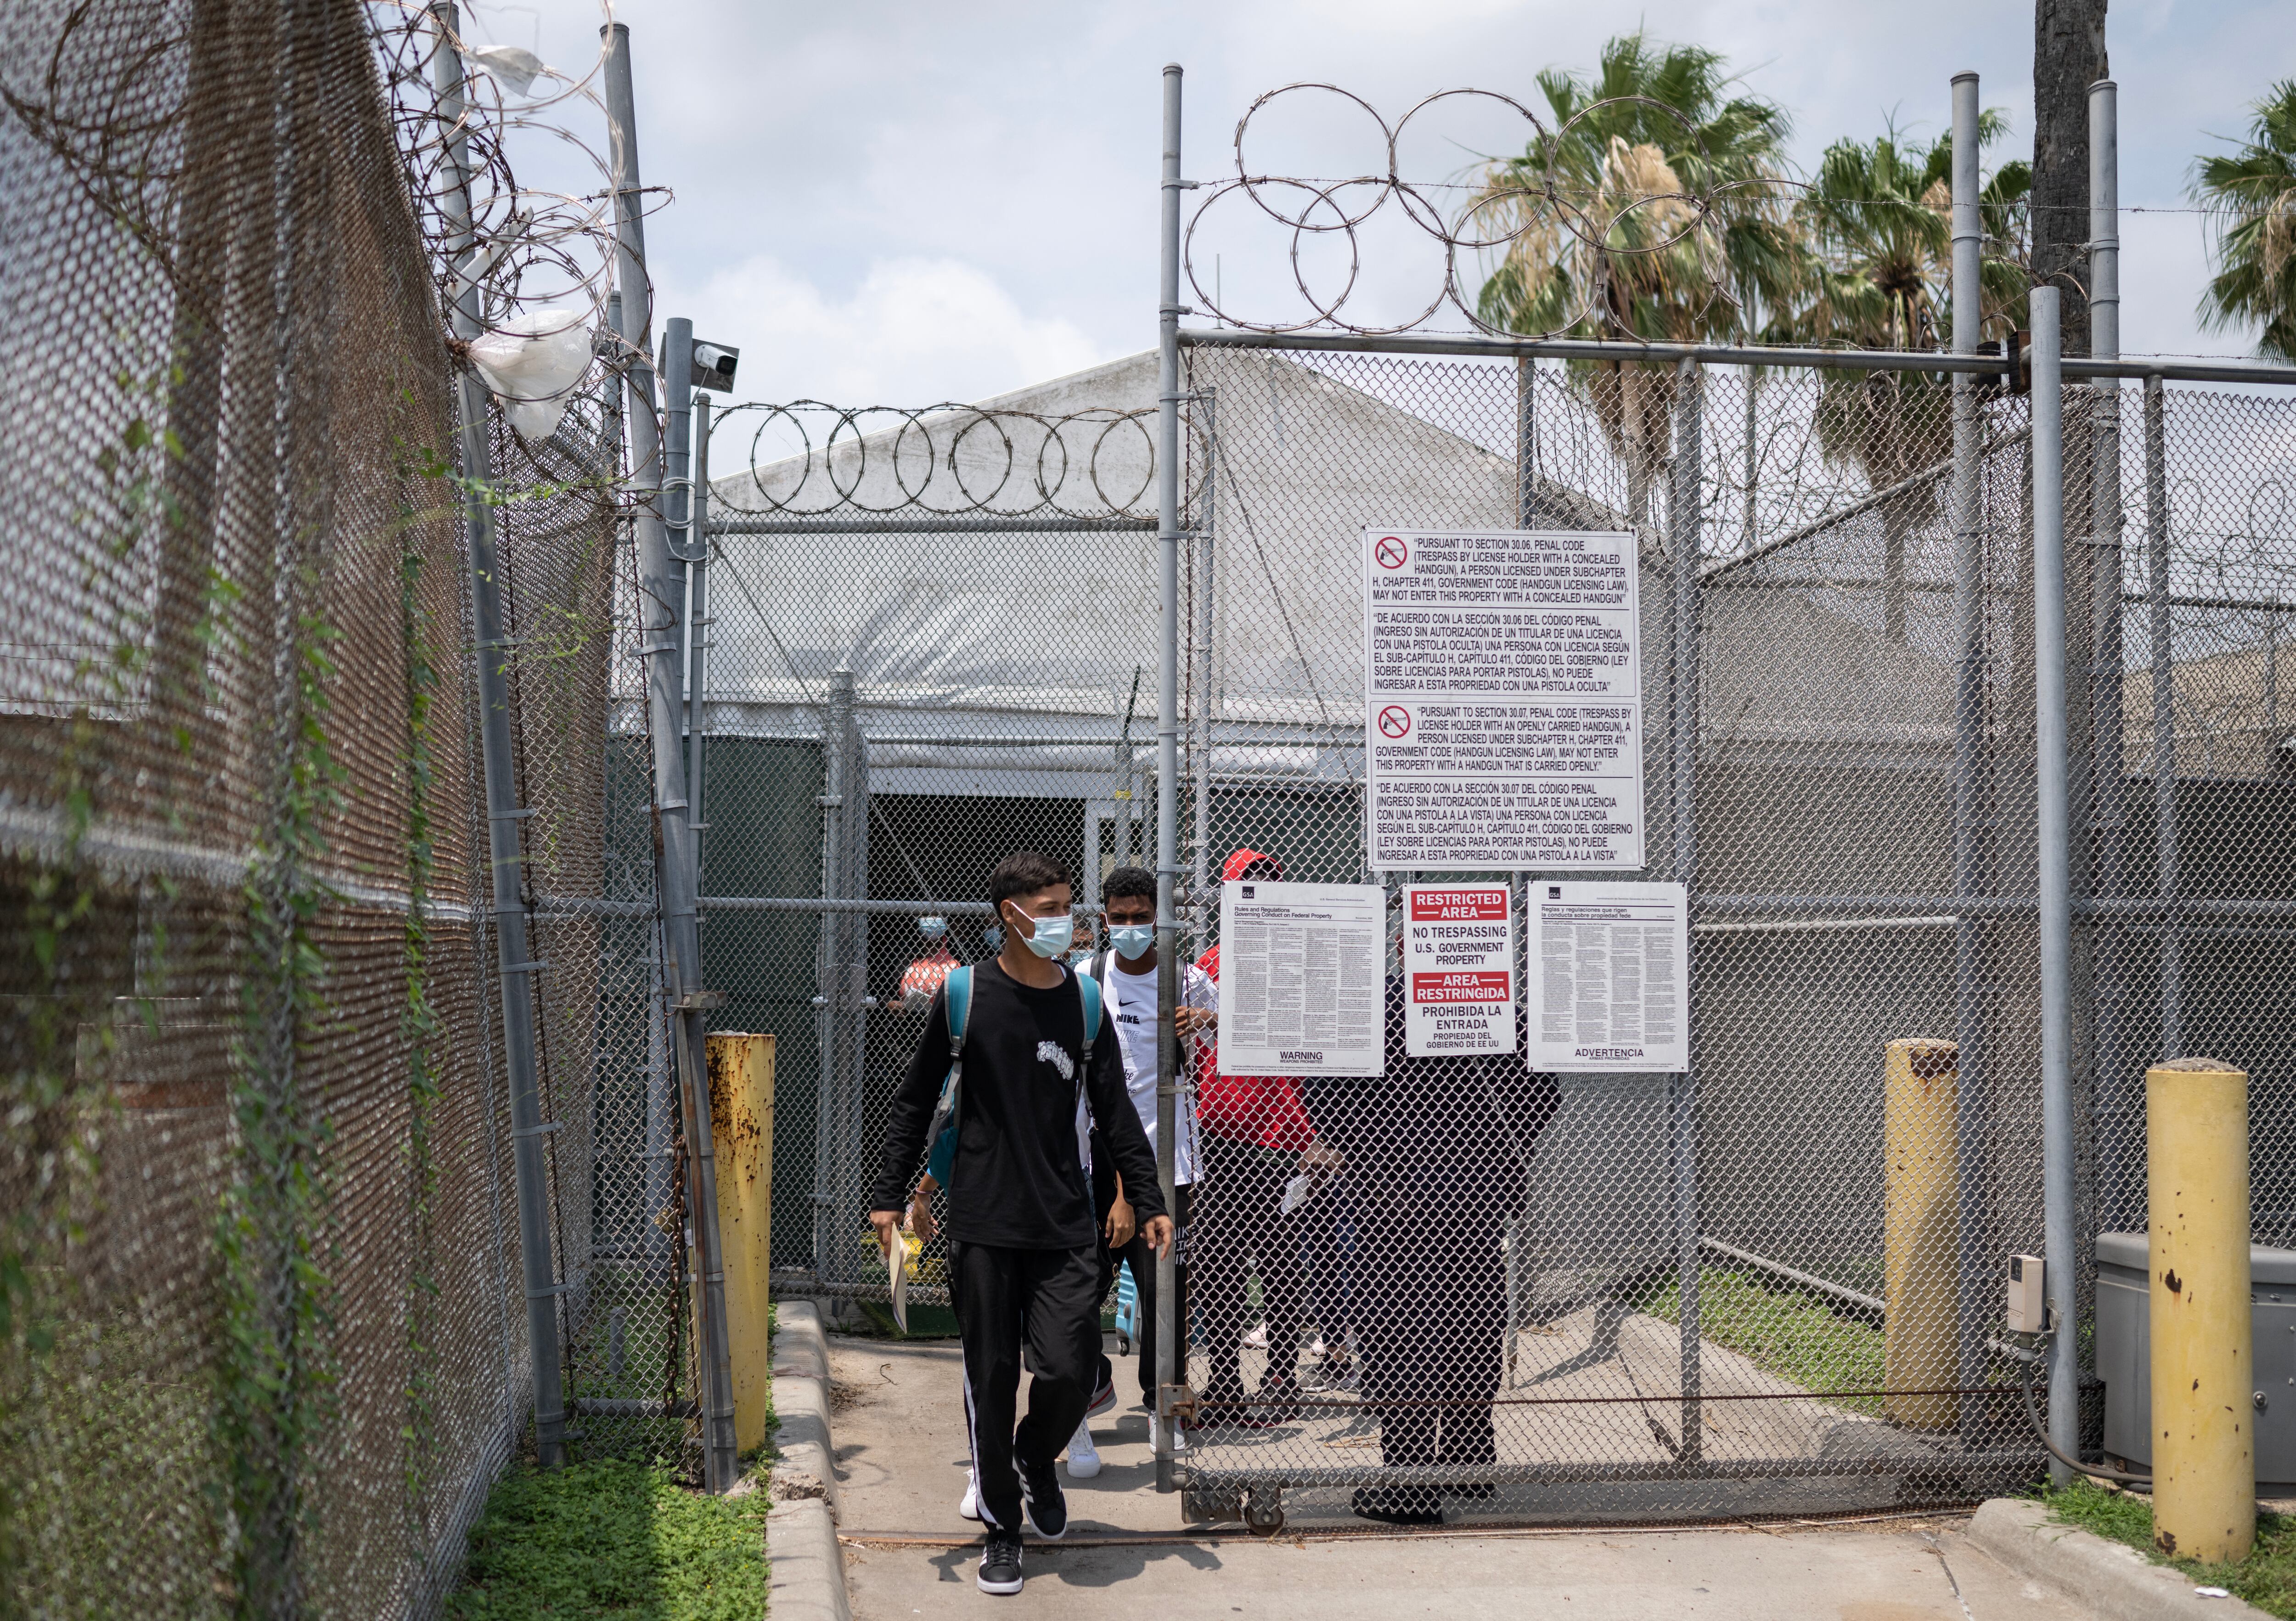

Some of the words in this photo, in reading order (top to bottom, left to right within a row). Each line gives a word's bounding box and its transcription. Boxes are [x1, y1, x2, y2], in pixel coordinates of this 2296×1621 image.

[1462, 539, 1473, 548] TO
[1475, 539, 1509, 549] SECTION
[1511, 540, 1532, 551] 30.06,
[1535, 540, 1560, 550] PENAL
[1563, 540, 1584, 551] CODE
[1414, 551, 1458, 563] (TRESPASS
[1460, 552, 1470, 562] BY
[1473, 552, 1505, 562] LICENSE
[1508, 552, 1540, 563] HOLDER
[1542, 553, 1561, 563] WITH
[1564, 553, 1570, 563] A
[1572, 553, 1620, 564] CONCEALED
[1414, 564, 1458, 577] HANDGUN),
[1460, 565, 1466, 574] A
[1469, 565, 1500, 575] PERSON
[1503, 565, 1541, 576] LICENSED
[1543, 566, 1570, 576] UNDER
[1573, 567, 1625, 577] SUBCHAPTER
[1373, 577, 1380, 588] H,
[1383, 577, 1420, 587] CHAPTER
[1422, 577, 1435, 589] 411,
[1438, 578, 1493, 588] GOVERNMENT
[1496, 579, 1517, 589] CODE
[1520, 579, 1561, 591] (HANDGUN
[1564, 580, 1604, 590] LICENSING
[1607, 580, 1628, 592] LAW),
[1373, 590, 1390, 600] MAY
[1392, 590, 1408, 600] NOT
[1411, 591, 1436, 601] ENTER
[1439, 591, 1456, 601] THIS
[1459, 591, 1501, 602] PROPERTY
[1503, 591, 1522, 602] WITH
[1525, 592, 1531, 602] A
[1533, 592, 1581, 602] CONCEALED
[1390, 613, 1430, 623] ACUERDO
[1432, 614, 1449, 624] CON
[1452, 614, 1463, 624] LA
[1465, 612, 1500, 624] SECCIÓN
[1503, 614, 1521, 625] 30.06
[1524, 615, 1539, 625] DEL
[1542, 613, 1573, 625] CÓDIGO
[1576, 615, 1601, 626] PENAL
[1373, 626, 1412, 638] (INGRESO
[1414, 626, 1427, 636] SIN
[1430, 625, 1489, 637] AUTORIZACIÓN
[1491, 628, 1502, 637] DE
[1505, 628, 1515, 637] UN
[1518, 628, 1551, 638] TITULAR
[1554, 629, 1564, 638] DE
[1567, 629, 1583, 638] UNA
[1586, 629, 1622, 639] LICENCIA
[1374, 665, 1402, 676] SOBRE
[1405, 666, 1446, 676] LICENCIAS
[1449, 666, 1471, 676] PARA
[1474, 667, 1505, 677] PORTAR
[1508, 667, 1550, 680] PISTOLAS),
[1553, 668, 1564, 678] NO
[1567, 668, 1593, 678] PUEDE
[1463, 707, 1473, 717] TO
[1475, 707, 1507, 717] SECTION
[1509, 707, 1527, 718] 30.07,
[1530, 708, 1554, 718] PENAL
[1556, 708, 1577, 718] CODE
[1579, 708, 1619, 720] (TRESPASS
[1621, 709, 1631, 718] BY
[1418, 720, 1449, 730] LICENSE
[1451, 720, 1481, 730] HOLDER
[1484, 720, 1502, 730] WITH
[1504, 721, 1514, 731] AN
[1517, 720, 1546, 731] OPENLY
[1548, 721, 1580, 731] CARRIED
[1583, 721, 1623, 734] HANDGUN),
[1625, 722, 1631, 732] A
[1393, 782, 1431, 793] ACUERDO
[1433, 783, 1450, 793] CON
[1452, 783, 1463, 793] LA
[1465, 781, 1499, 794] SECCIÓN
[1501, 783, 1519, 794] 30.07
[1522, 783, 1537, 794] DEL
[1539, 781, 1569, 794] CÓDIGO
[1571, 784, 1597, 794] PENAL
[1377, 836, 1394, 849] (LEY
[1396, 837, 1424, 846] SOBRE
[1426, 837, 1466, 846] LICENCIAS
[1469, 837, 1490, 847] PARA
[1492, 837, 1523, 847] PORTAR
[1525, 837, 1566, 849] PISTOLAS),
[1569, 837, 1580, 847] NO
[1582, 837, 1608, 847] PUEDE
[1417, 893, 1502, 905] RESTRICTED
[1441, 907, 1478, 918] AREA
[1413, 927, 1428, 938] NO
[1431, 926, 1507, 938] TRESPASSING
[1416, 943, 1435, 953] U.S.
[1439, 942, 1504, 952] GOVERNMENT
[1436, 955, 1486, 965] PROPERTY
[1443, 975, 1480, 986] AREA
[1417, 987, 1506, 1000] RESTRINGIDA
[1423, 1006, 1484, 1017] PROHIBIDA
[1488, 1006, 1501, 1016] LA
[1116, 1014, 1140, 1024] NIKE
[1437, 1019, 1488, 1030] ENTRADA
[1117, 1029, 1140, 1043] NIKE
[1280, 1051, 1322, 1060] WARNING
[1575, 1048, 1644, 1057] ADVERTENCIA
